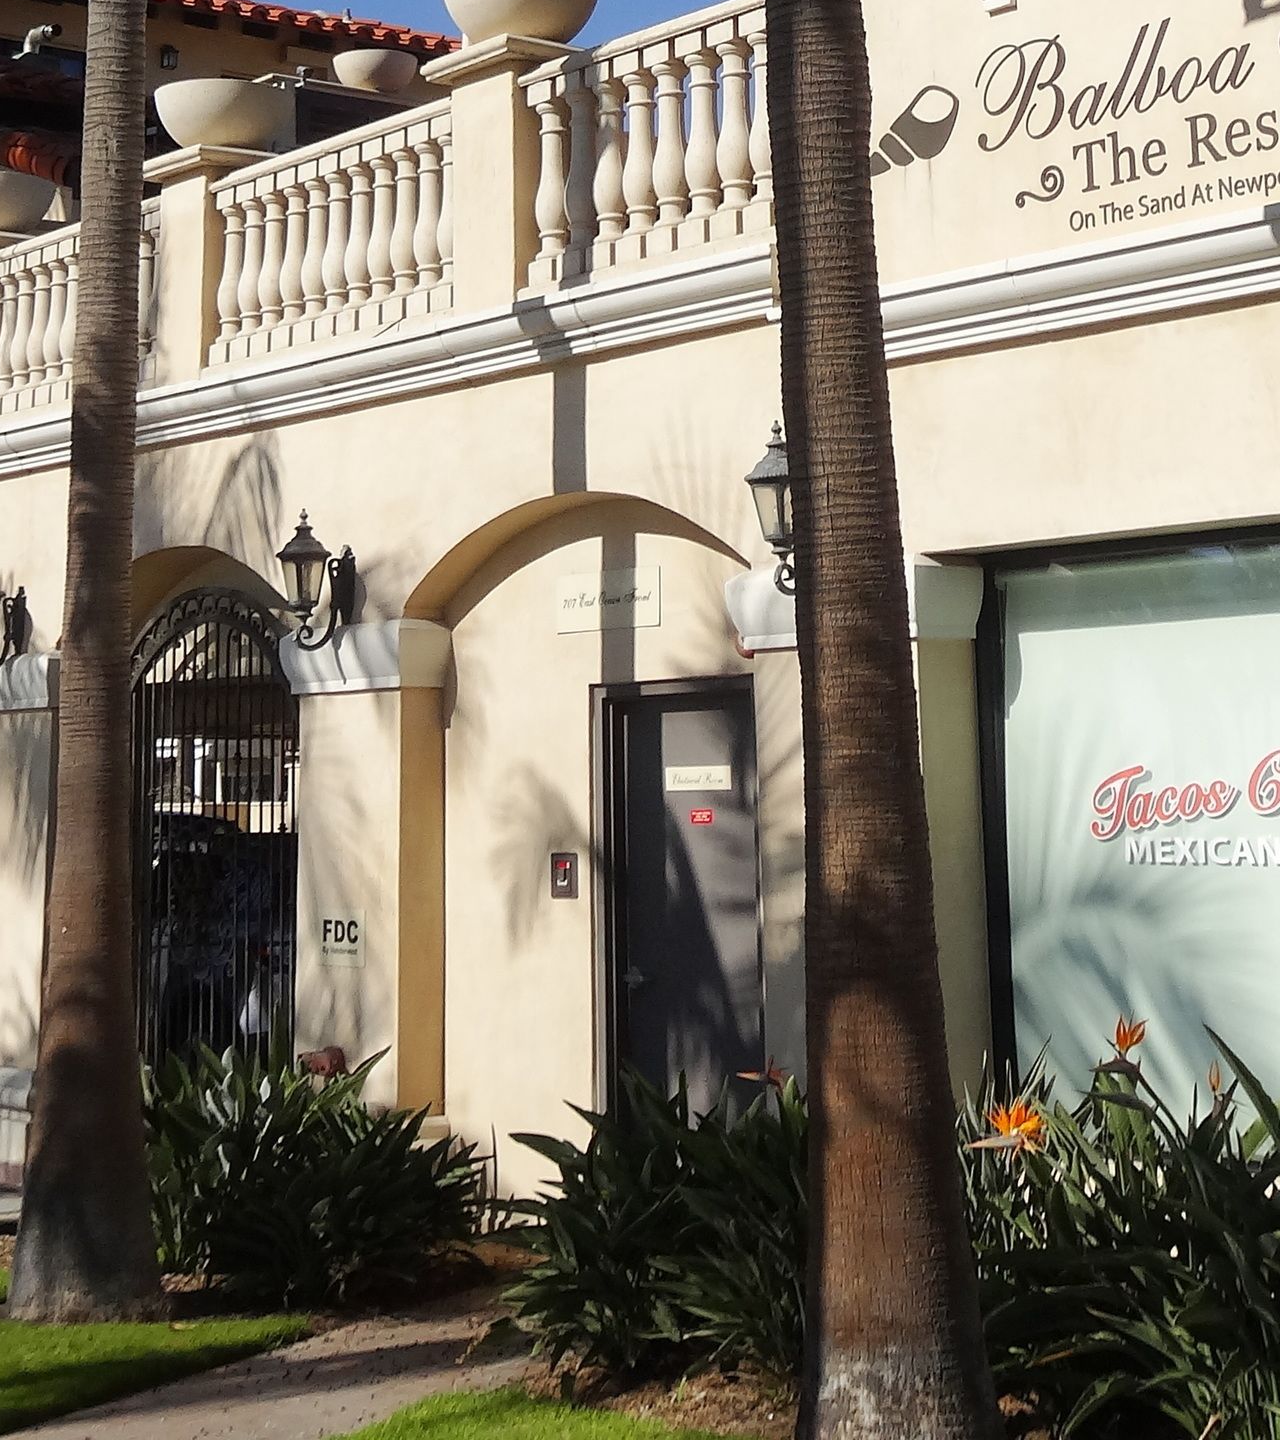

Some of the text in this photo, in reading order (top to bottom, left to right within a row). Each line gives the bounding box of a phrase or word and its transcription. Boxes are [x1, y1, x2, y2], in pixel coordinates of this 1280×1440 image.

[976, 17, 1255, 152] Balboa
[1073, 131, 1168, 193] The
[1070, 210, 1096, 232] On
[1099, 202, 1134, 226] The
[1139, 186, 1187, 217] Sand
[1191, 183, 1214, 206] At
[1089, 764, 1239, 841] Tacos
[322, 919, 358, 944] FDC
